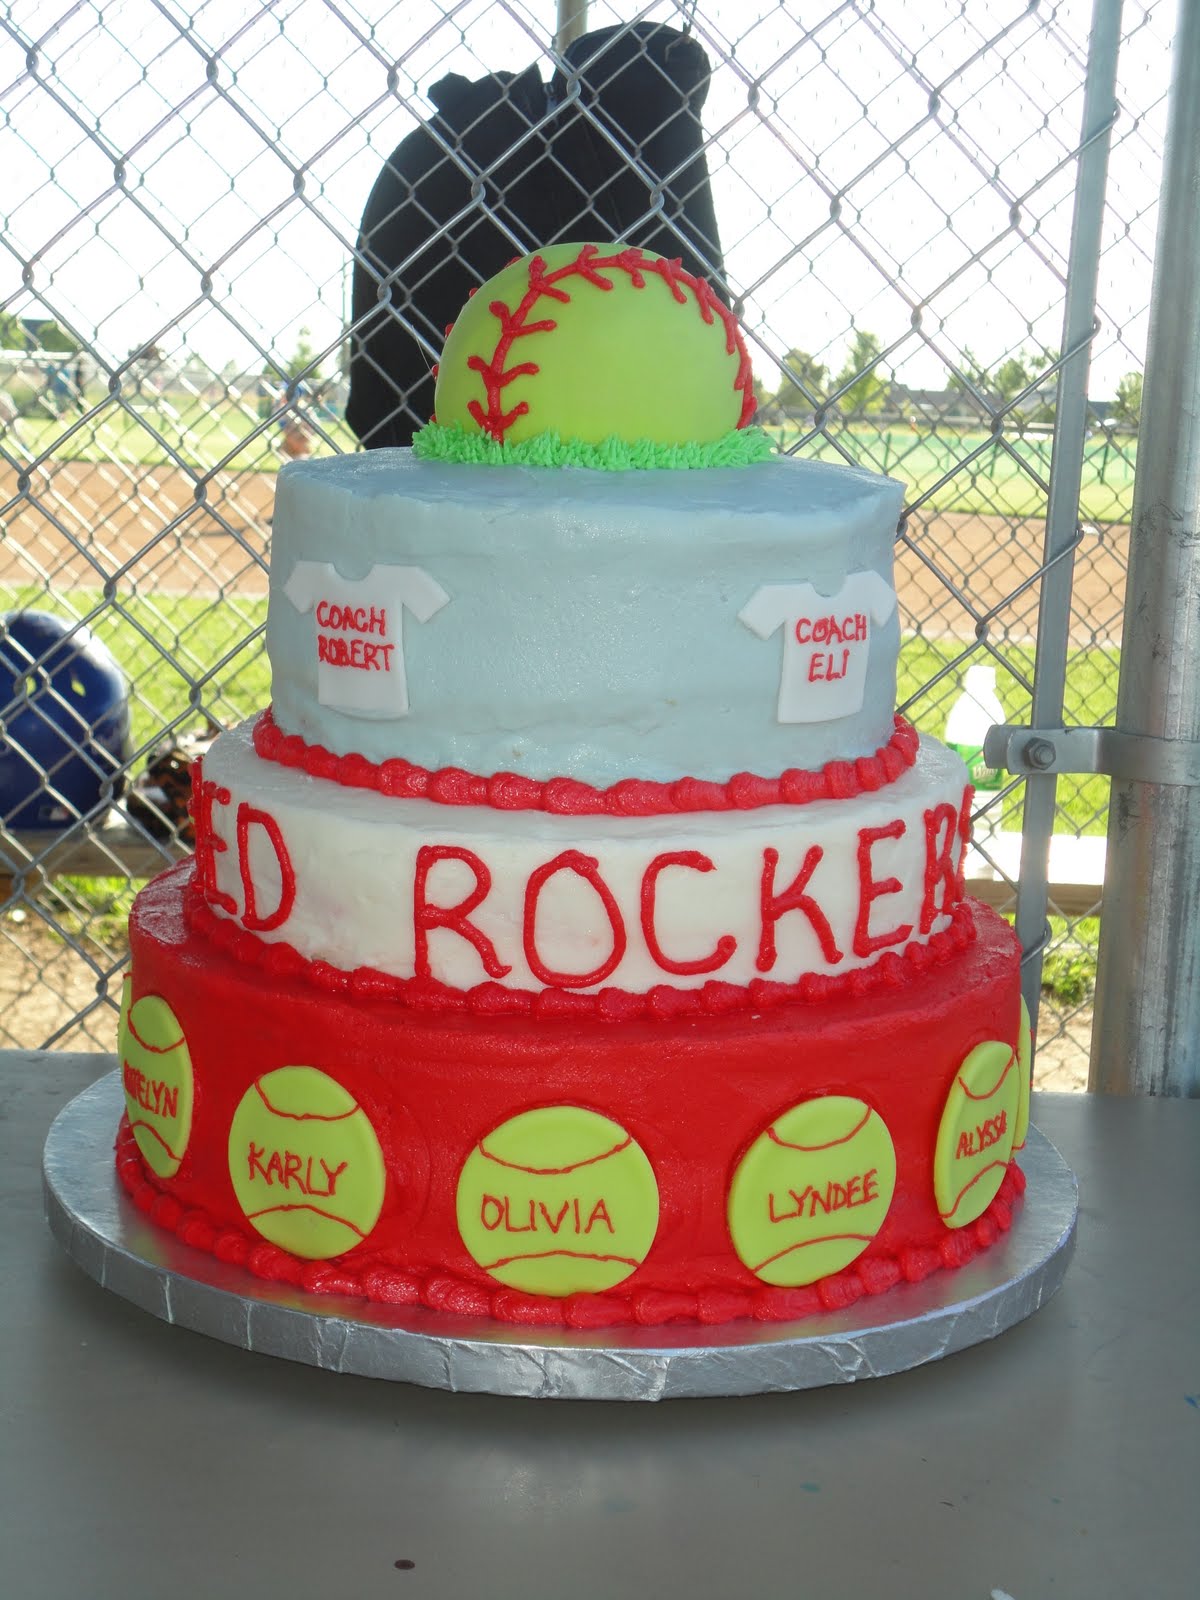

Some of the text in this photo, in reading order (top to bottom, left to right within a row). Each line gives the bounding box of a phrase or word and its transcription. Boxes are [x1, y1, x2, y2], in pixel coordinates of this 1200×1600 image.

[316, 600, 387, 636] COACH
[796, 613, 867, 645] COACH
[317, 634, 395, 672] ROBERT
[807, 648, 850, 683] ELI
[191, 772, 976, 989] ED ROCKER
[247, 1141, 348, 1197] KARLY
[480, 1193, 616, 1235] OLIVIA
[768, 1168, 880, 1224] LYNDEE
